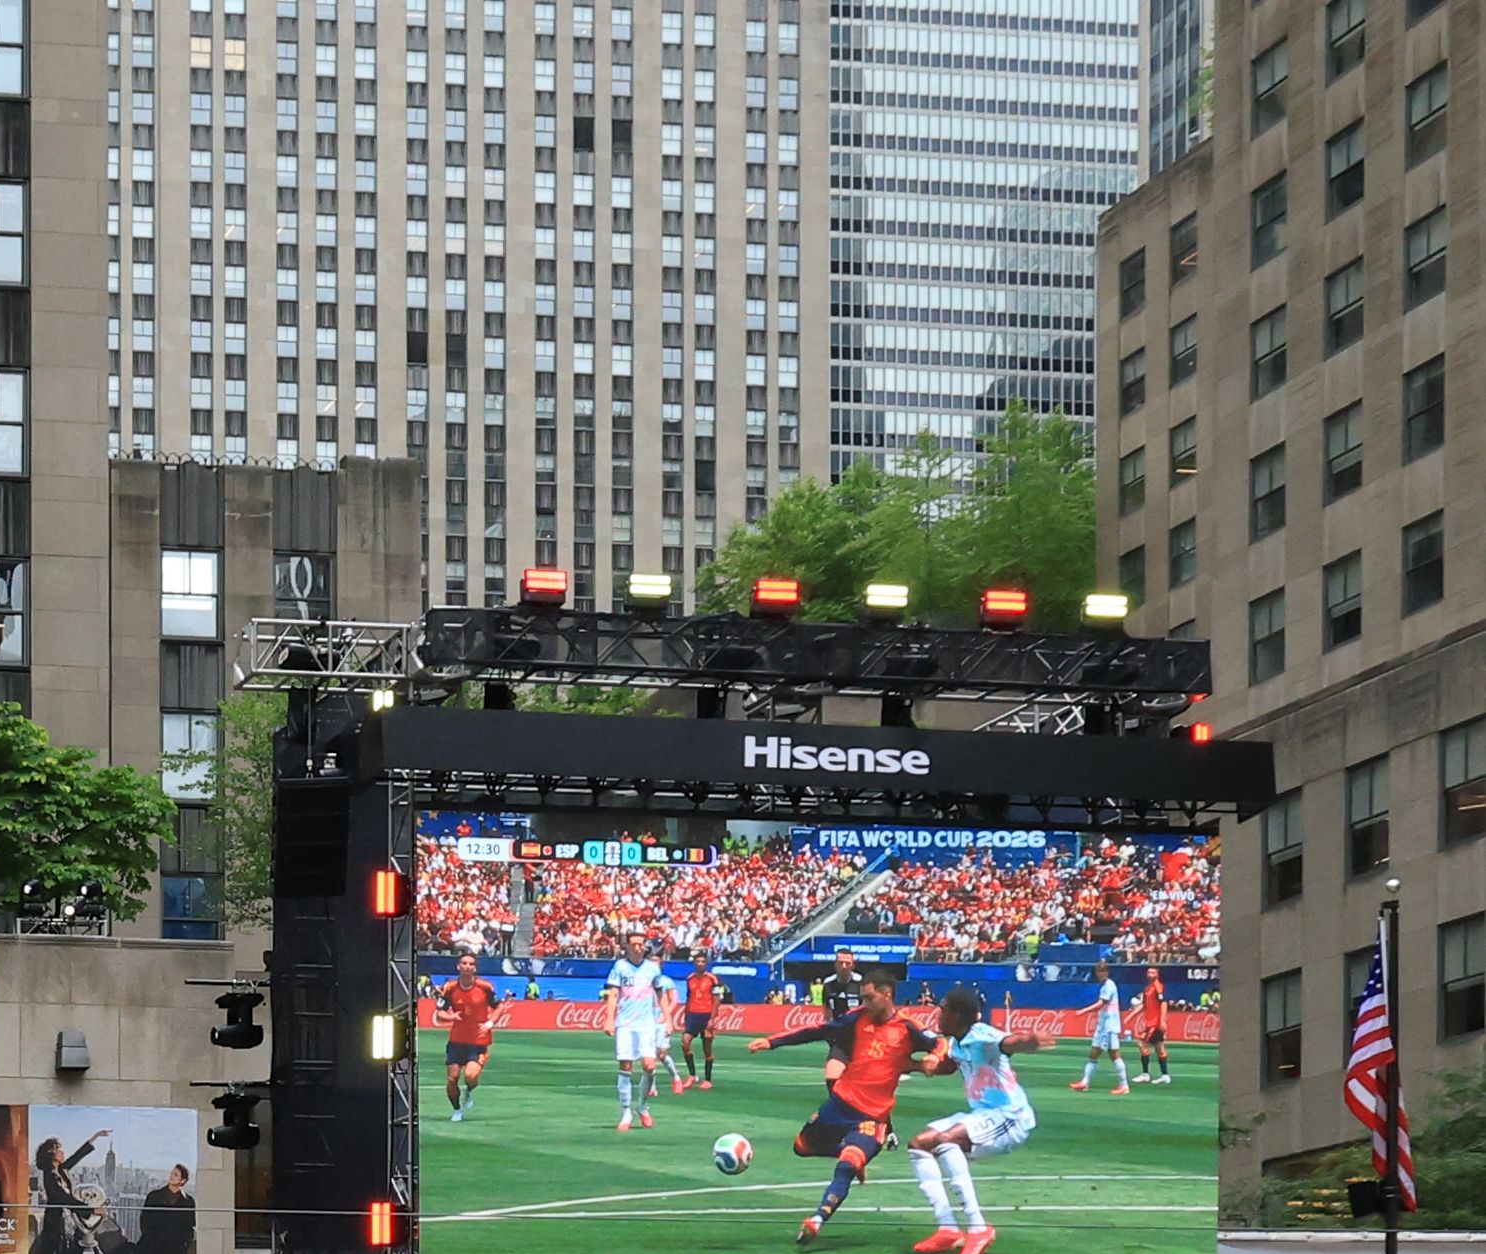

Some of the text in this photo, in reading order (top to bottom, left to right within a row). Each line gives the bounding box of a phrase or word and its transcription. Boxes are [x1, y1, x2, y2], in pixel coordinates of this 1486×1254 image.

[743, 735, 930, 775] Hisense
[819, 830, 1047, 848] FIFA WORLD CUP 2026
[466, 842, 501, 856] 12:30
[555, 844, 579, 859] ESP
[647, 846, 669, 862] BEL
[1152, 890, 1196, 902] EN VIVO
